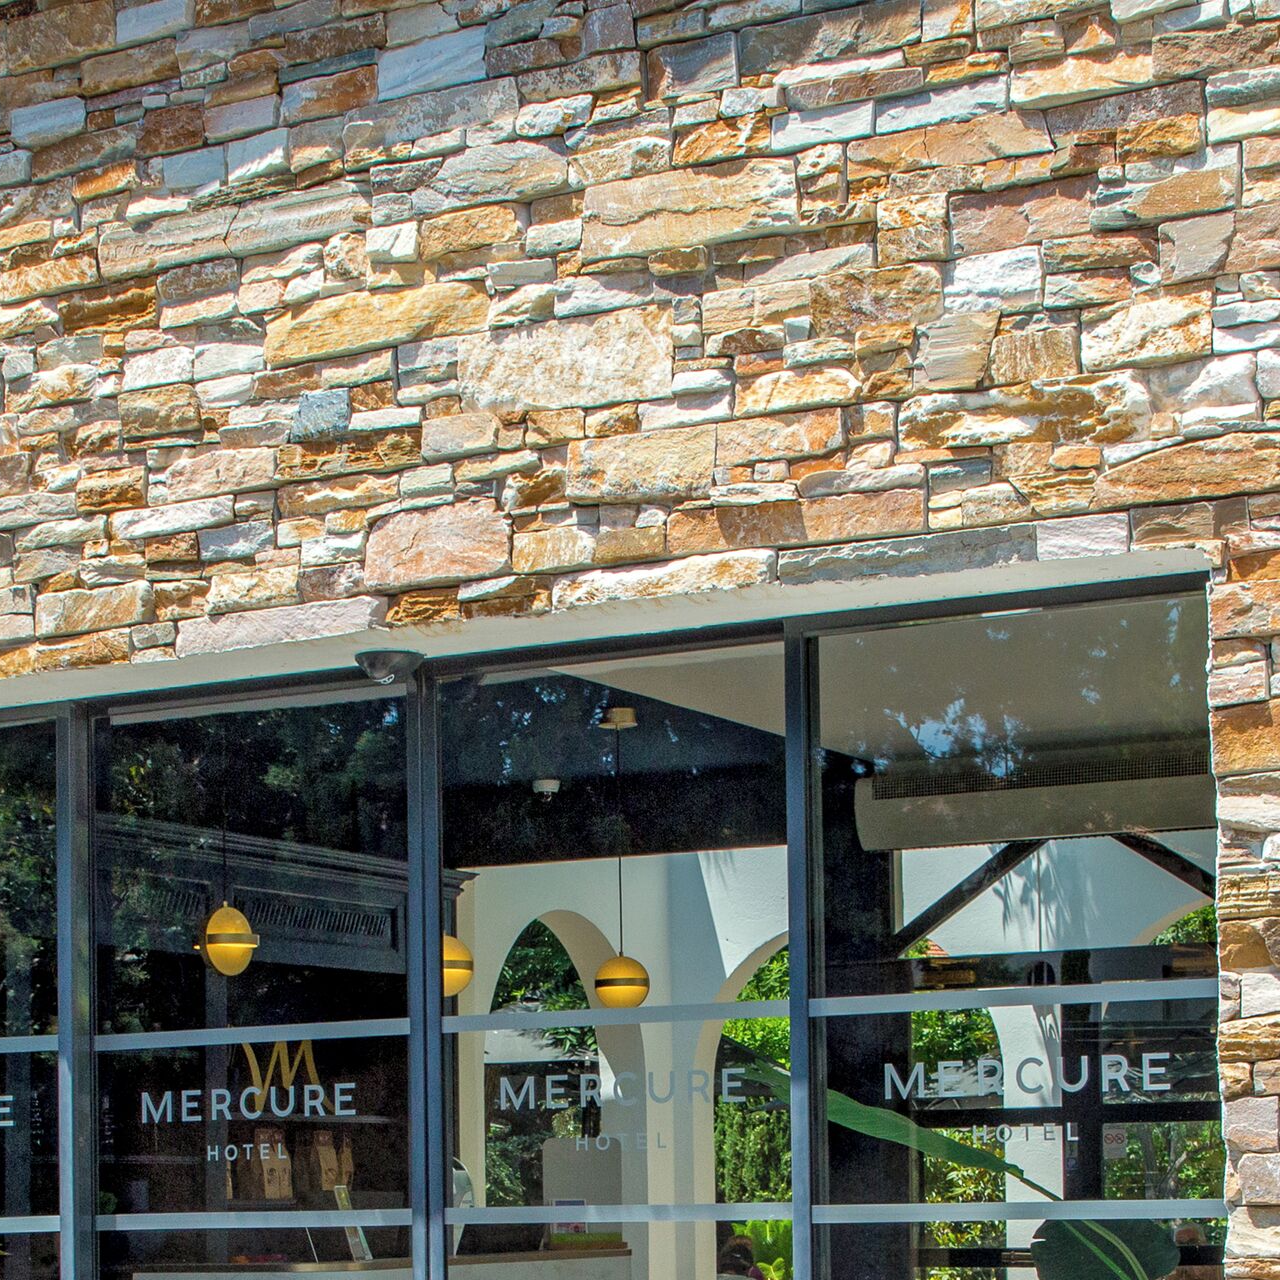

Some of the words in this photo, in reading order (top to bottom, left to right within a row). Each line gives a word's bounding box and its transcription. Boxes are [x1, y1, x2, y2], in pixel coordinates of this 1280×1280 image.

[498, 1067, 747, 1112] MERCURE
[883, 1052, 1171, 1101] MERCURE
[140, 1082, 358, 1125] MERCURE
[576, 1131, 668, 1151] HOTEL
[972, 1121, 1079, 1144] HOTEL
[207, 1142, 288, 1162] HOTEL
